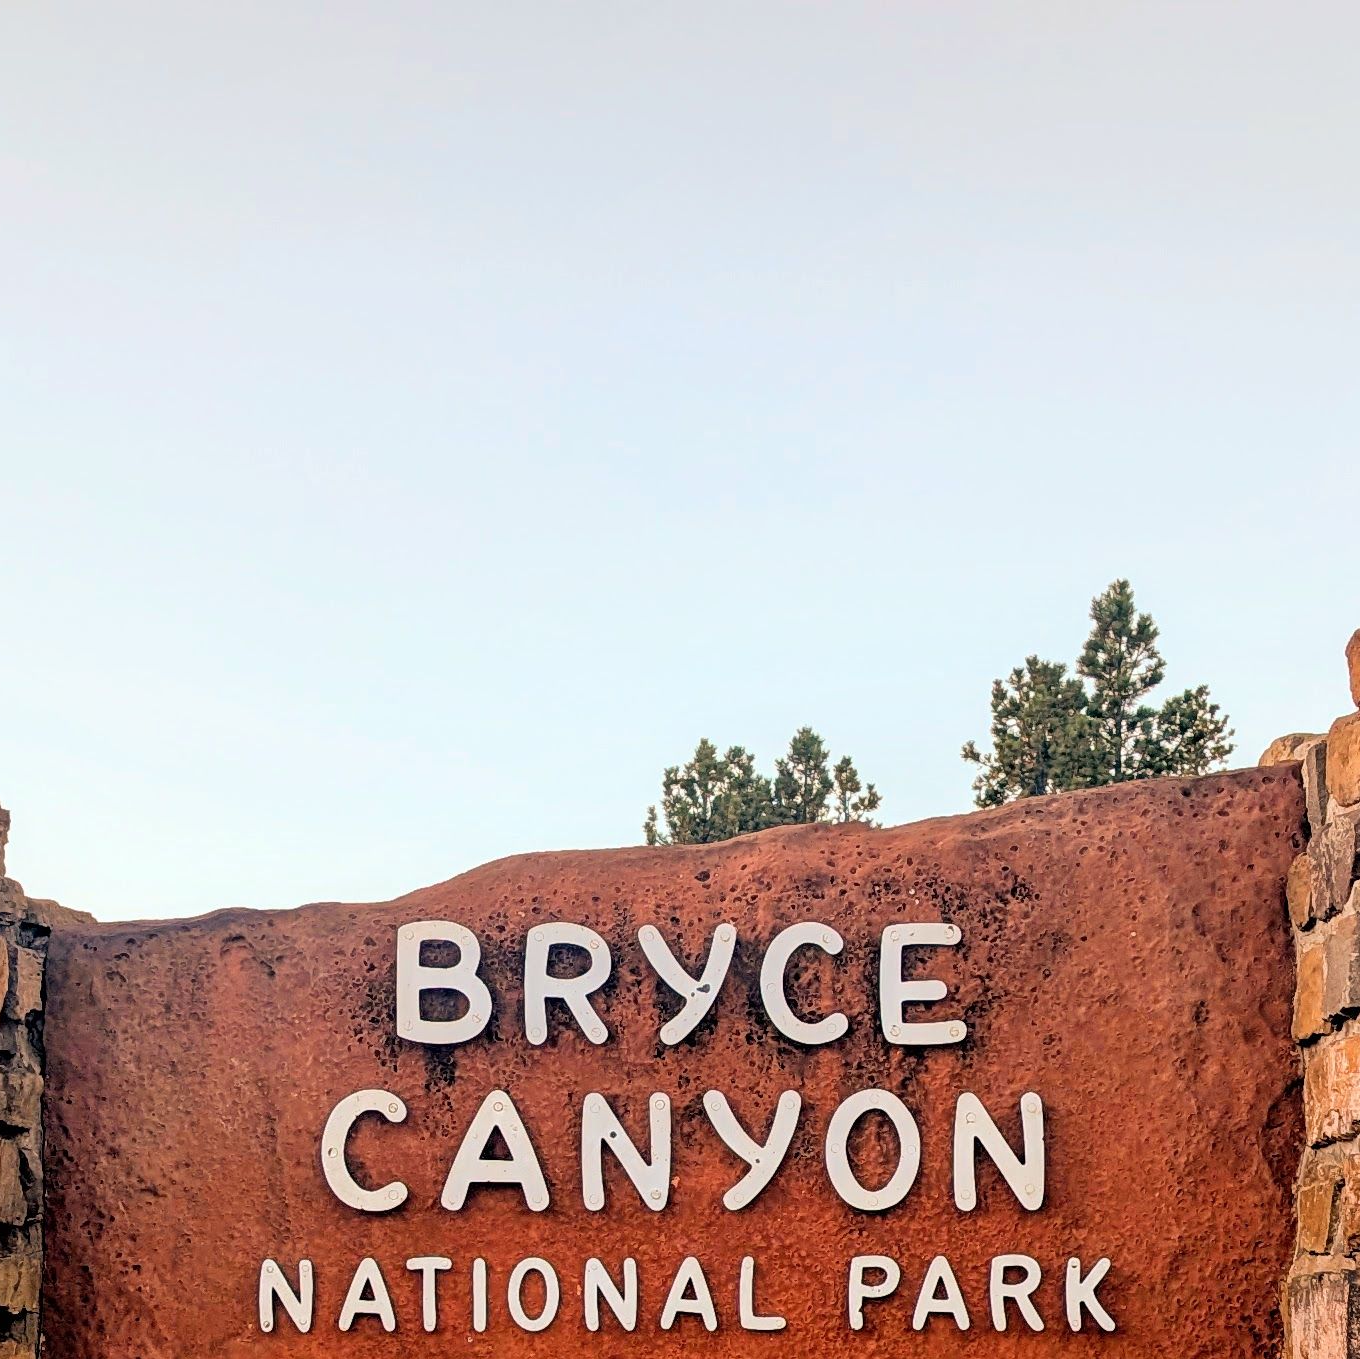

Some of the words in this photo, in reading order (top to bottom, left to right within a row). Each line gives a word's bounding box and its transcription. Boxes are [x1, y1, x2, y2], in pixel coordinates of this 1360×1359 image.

[396, 919, 970, 1046] BRYCE
[320, 1088, 1045, 1212] CANYON
[258, 1255, 787, 1334] NATIONAL
[848, 1253, 1116, 1332] PARK
